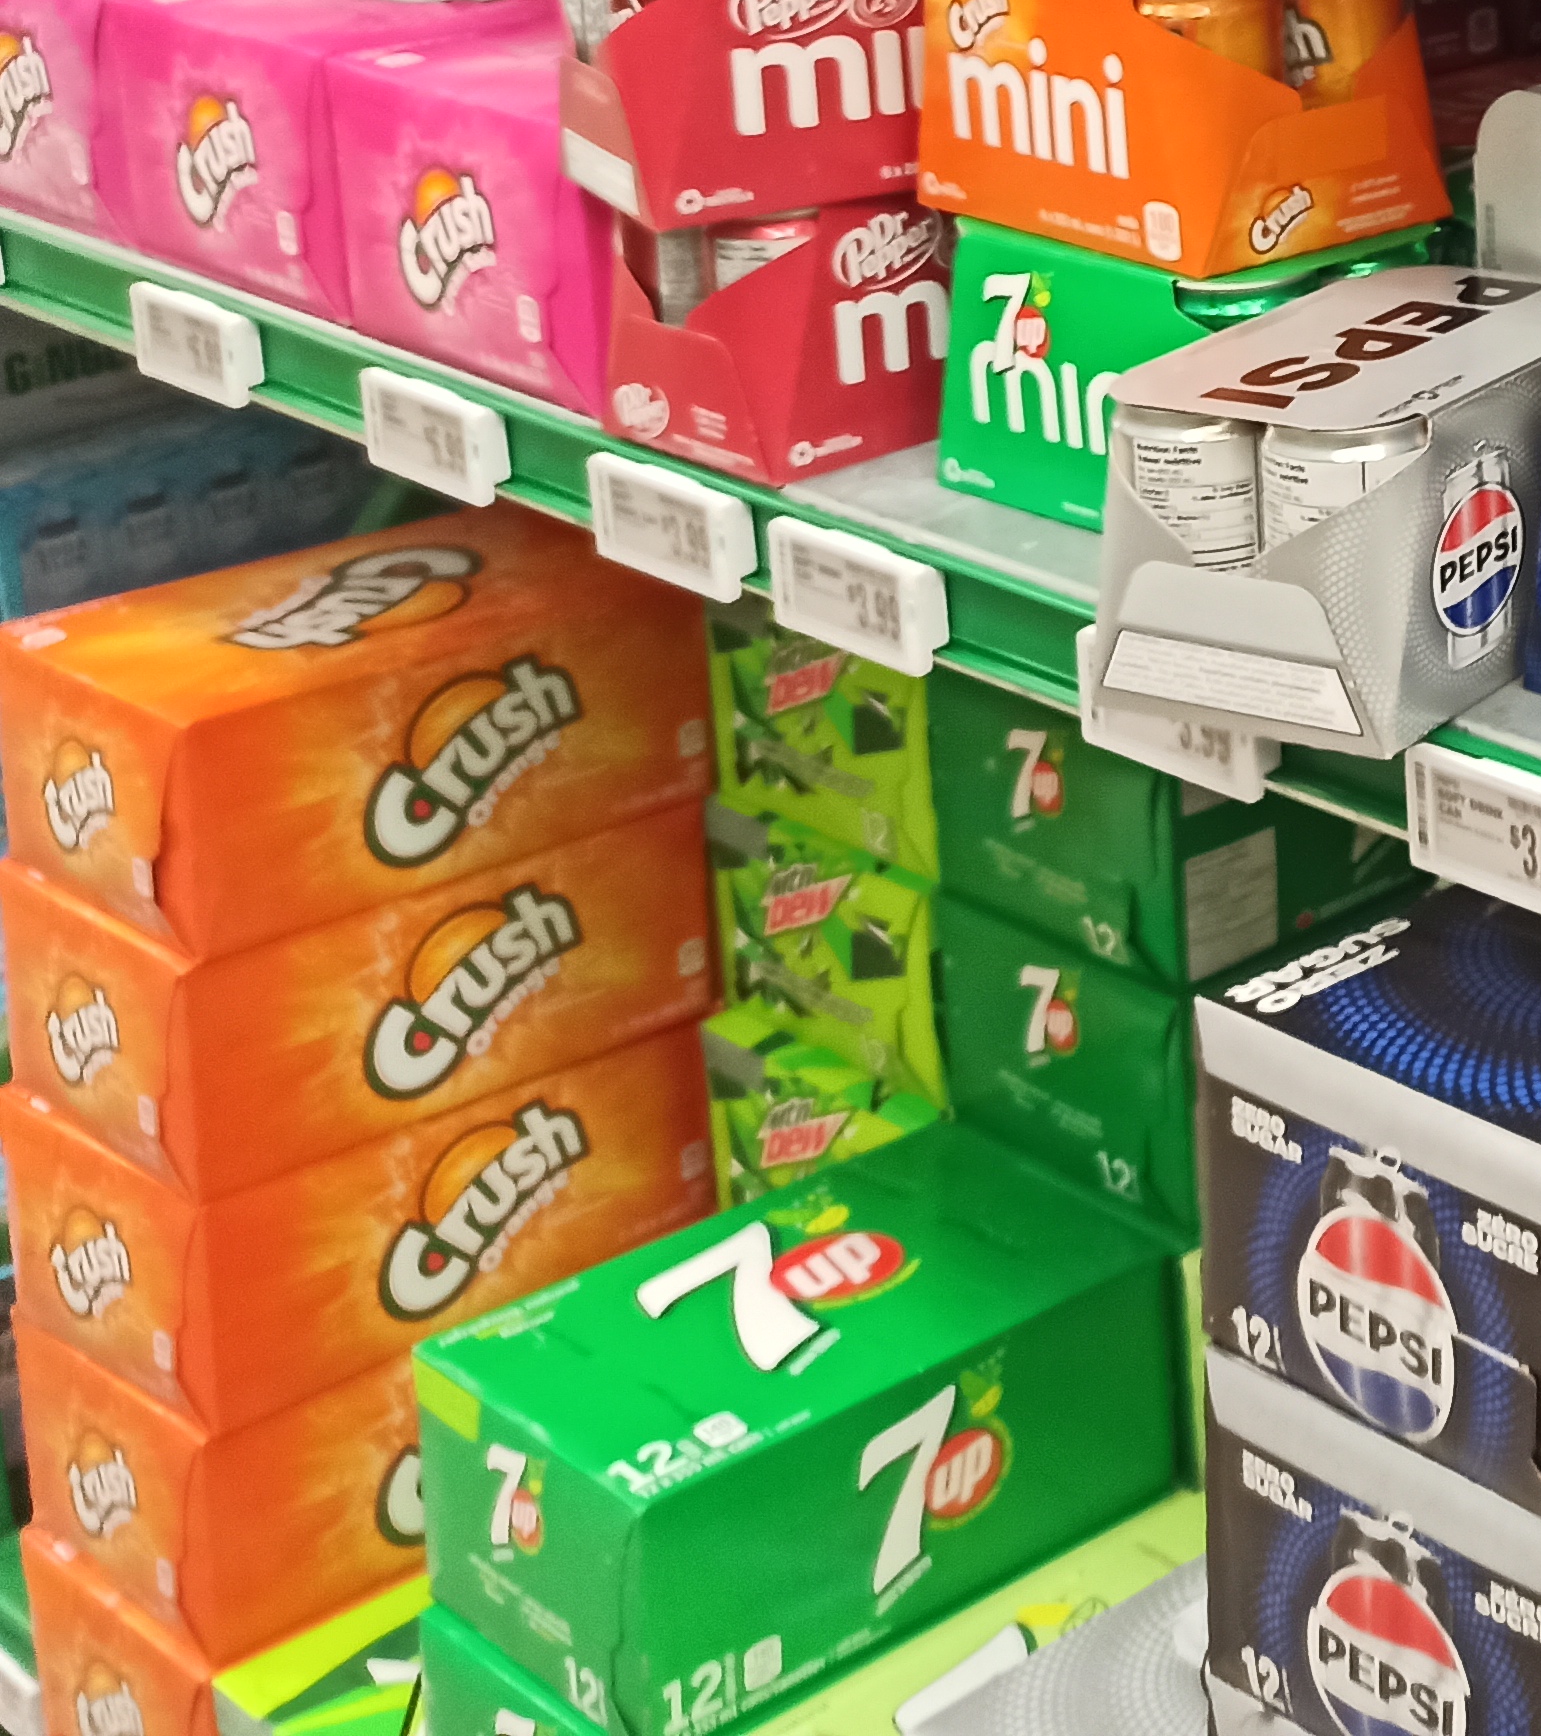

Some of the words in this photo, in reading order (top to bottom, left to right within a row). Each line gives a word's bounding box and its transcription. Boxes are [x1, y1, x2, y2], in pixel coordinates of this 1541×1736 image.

[947, 36, 1131, 180] mini
[177, 100, 258, 226] Crush
[400, 174, 496, 309] Crush
[1249, 185, 1316, 255] Crush
[1438, 523, 1520, 596] PEPSI
[44, 751, 115, 849] Crush
[371, 656, 582, 868] Crush
[367, 886, 582, 1098] Crush
[1223, 916, 1412, 1003] SUGAR
[1255, 943, 1401, 1014] ZERO
[47, 990, 118, 1084] Crush
[383, 1101, 590, 1319] Crush
[1231, 1305, 1277, 1370] 12
[1306, 1276, 1445, 1387] PEPSI
[1241, 1647, 1283, 1714] 12
[1317, 1630, 1455, 1736] PEPSI
